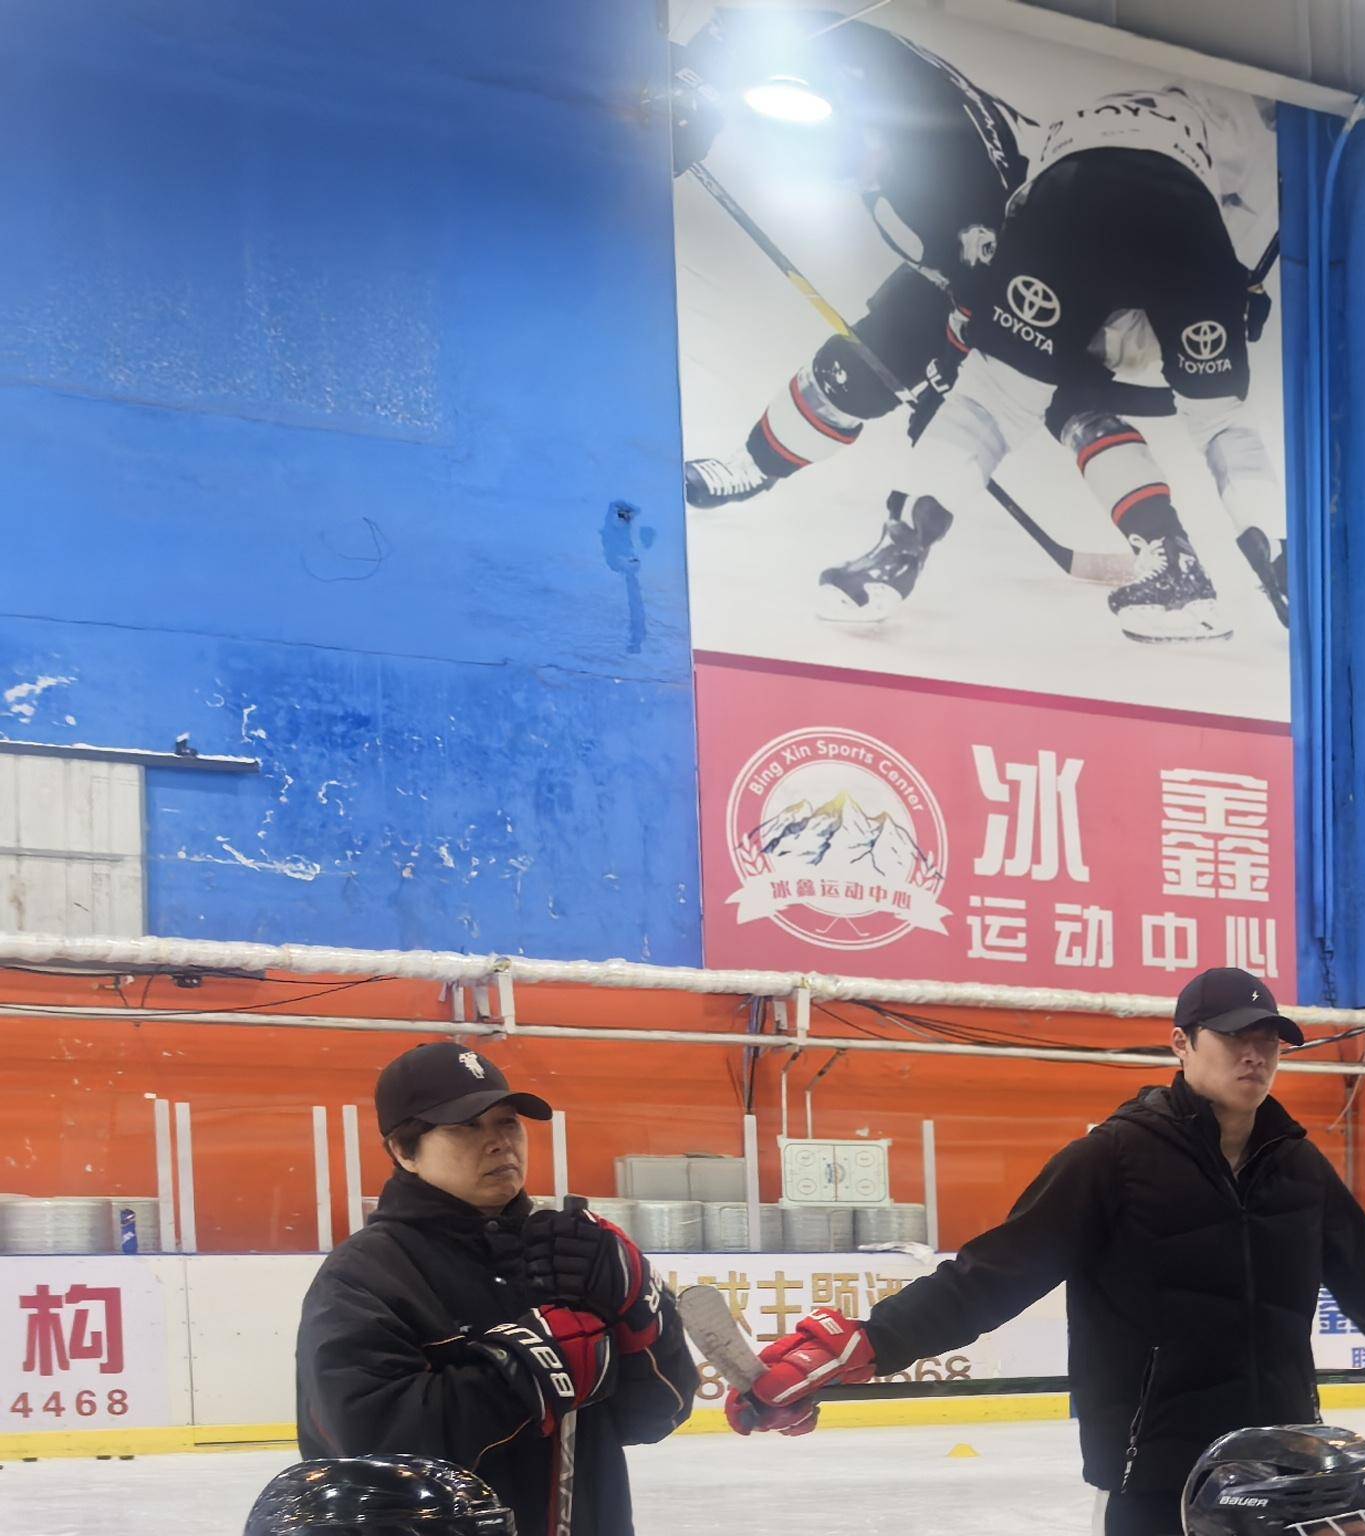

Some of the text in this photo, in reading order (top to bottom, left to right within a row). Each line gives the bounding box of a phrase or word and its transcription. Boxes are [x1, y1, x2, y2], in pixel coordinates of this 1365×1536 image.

[992, 305, 1054, 355] TOYOTA
[1177, 353, 1232, 374] TOYOTA
[748, 740, 924, 812] Bing Xin Sports Center
[971, 744, 1270, 902] 冰鑫
[966, 896, 1278, 979] 运动中心
[19, 1284, 124, 1377] 构
[10, 1387, 131, 1418] 4468
[1218, 1494, 1269, 1508] BAUER
